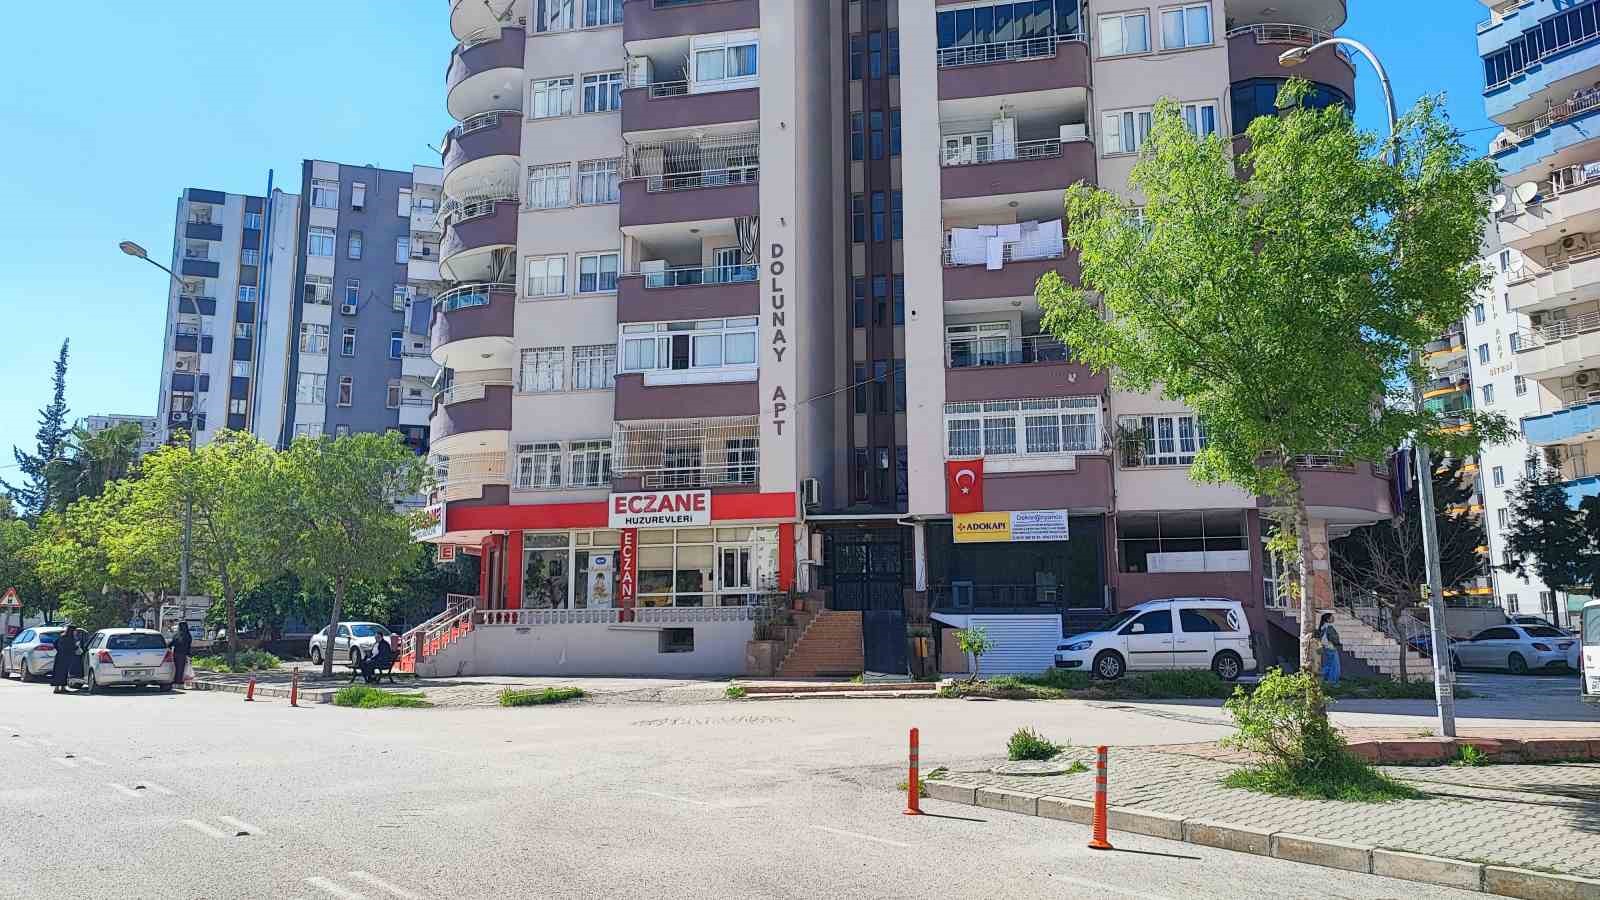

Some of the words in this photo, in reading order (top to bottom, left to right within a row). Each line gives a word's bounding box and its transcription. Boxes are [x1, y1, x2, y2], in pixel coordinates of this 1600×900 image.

[770, 243, 786, 362] DOLUNAY
[773, 386, 786, 436] APT
[615, 493, 706, 514] ECZANE
[625, 515, 693, 525] HUZUREVLERİ
[623, 532, 632, 601] ECZAN
